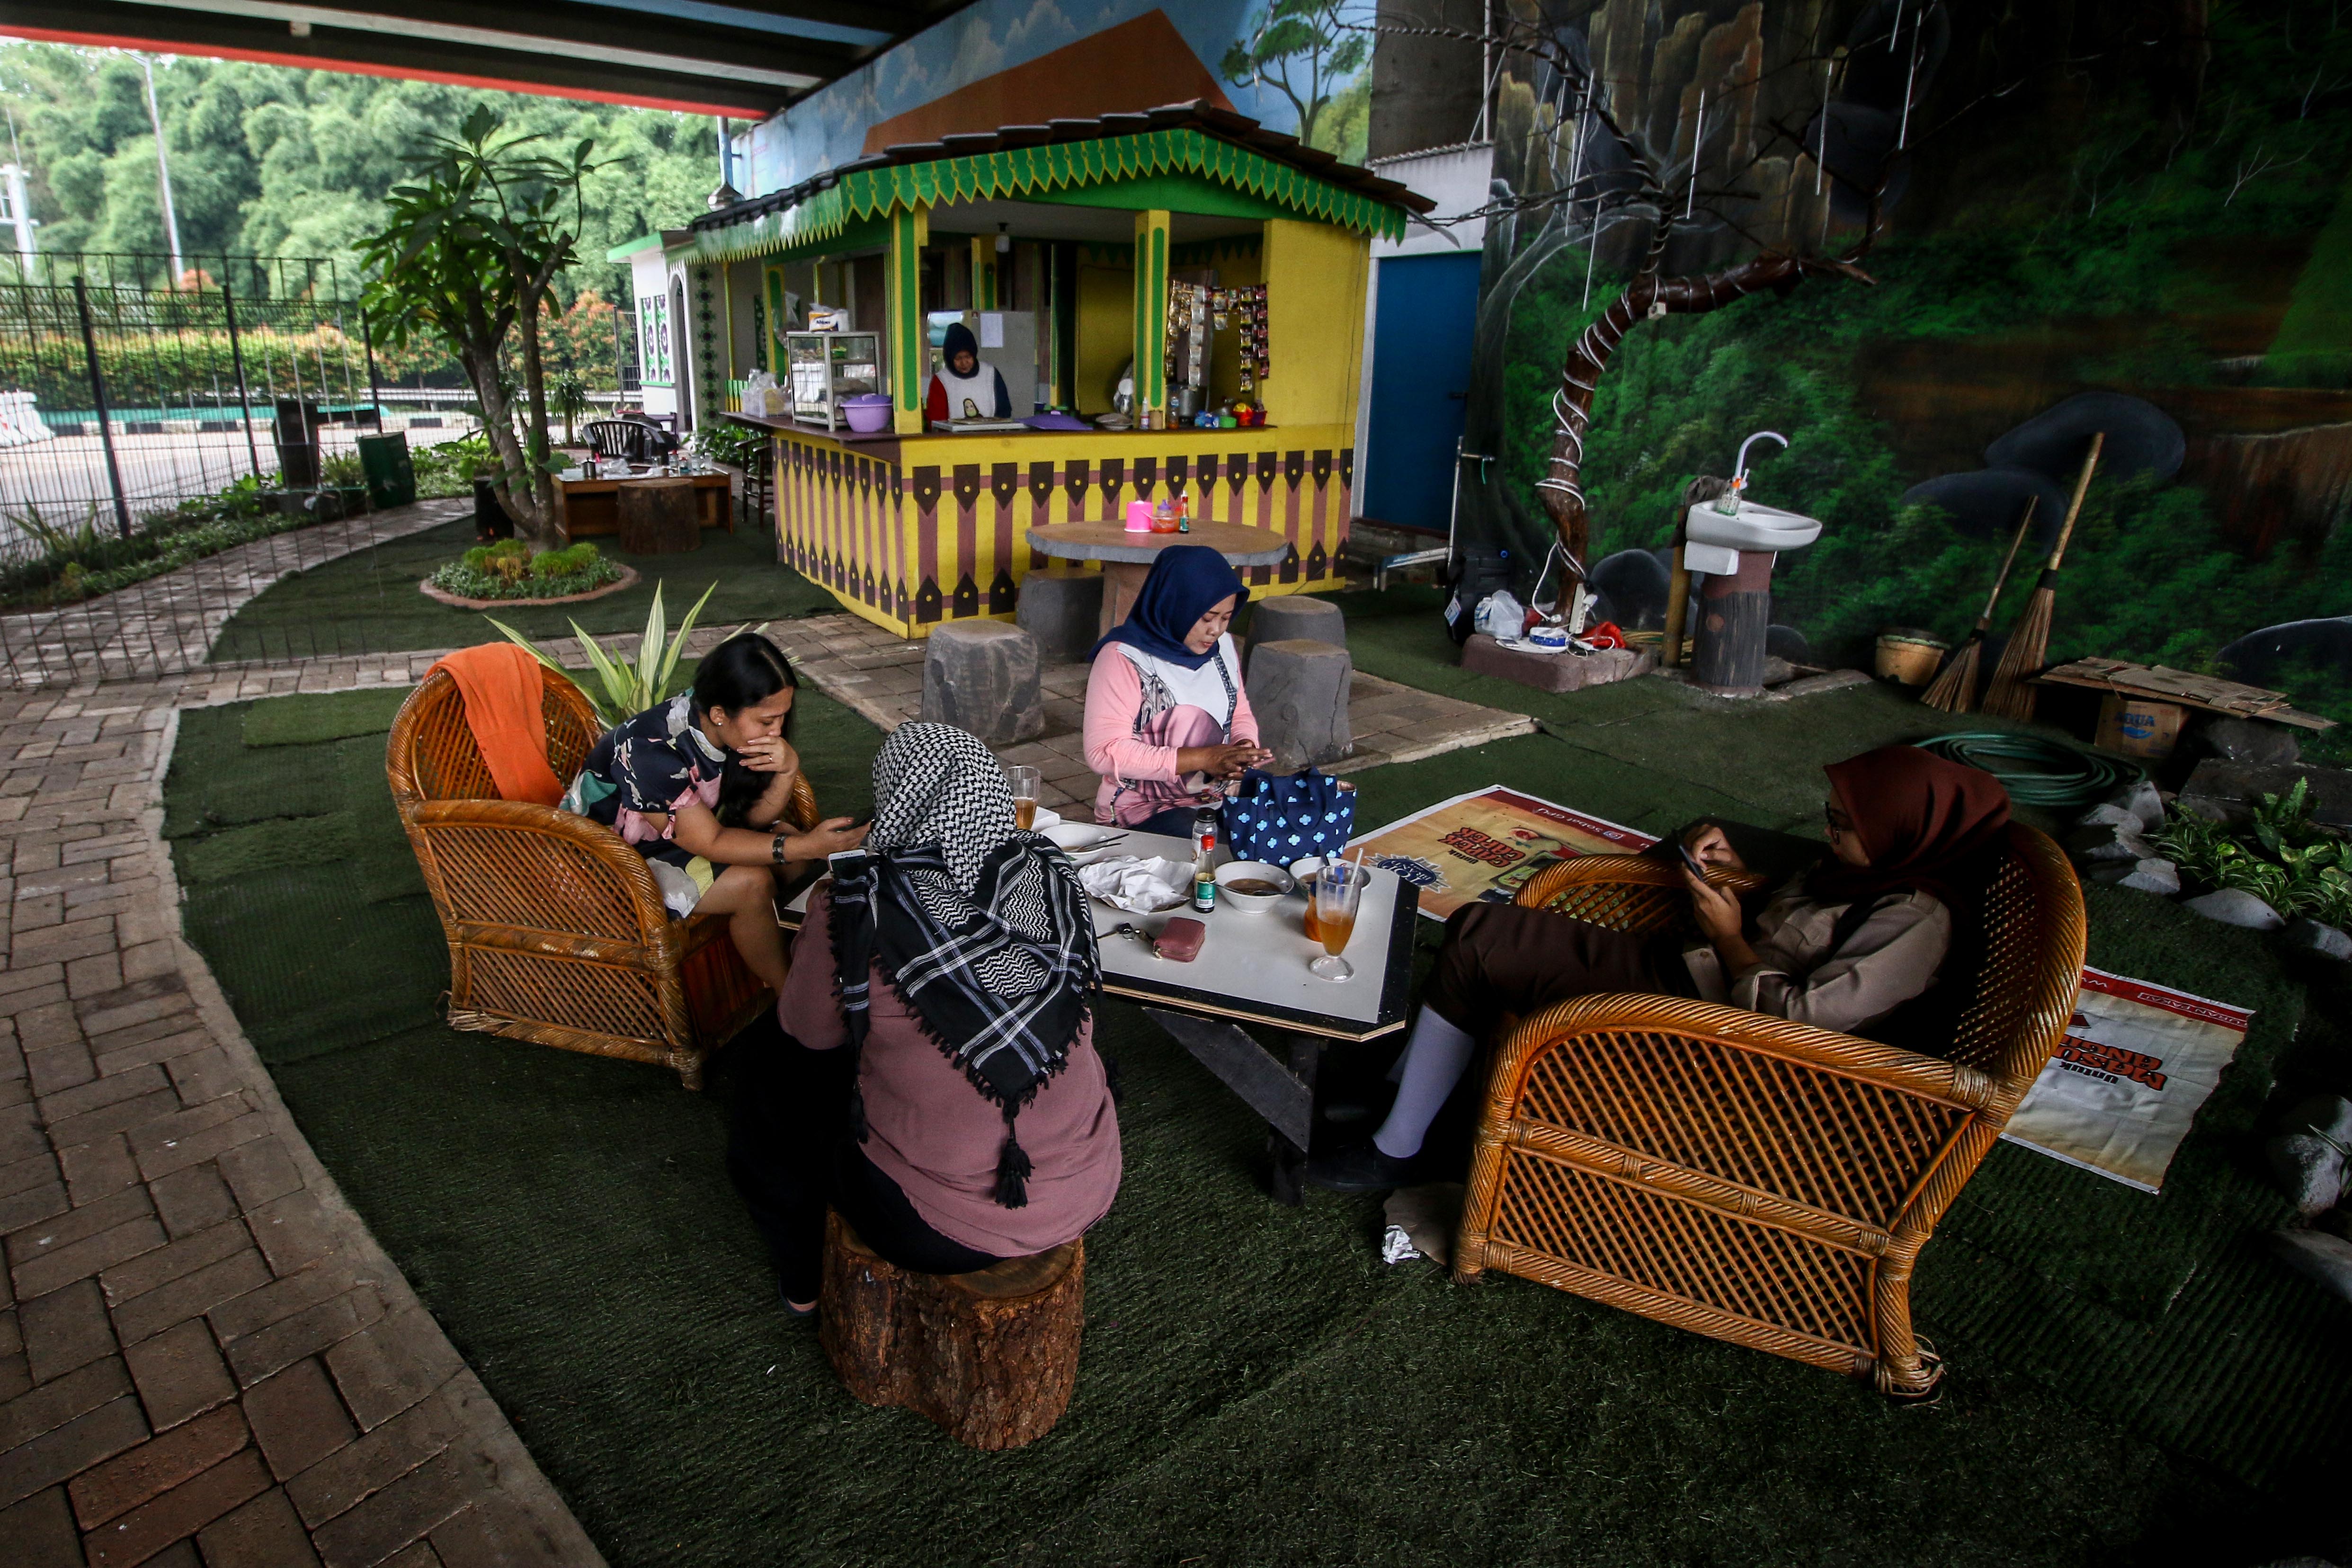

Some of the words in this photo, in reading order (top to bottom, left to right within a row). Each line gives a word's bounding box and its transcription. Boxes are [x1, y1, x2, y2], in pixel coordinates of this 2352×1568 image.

[2113, 711, 2155, 727] AQUA
[1437, 834, 1512, 868] CAPEK
[1452, 827, 1526, 861] CAPEK
[1381, 865, 1422, 885] TOP
[1391, 860, 1432, 881] BRAND
[2146, 995, 2191, 1010] PAKAI
[2052, 1044, 2168, 1091] MASU
[2058, 1061, 2119, 1084] Untuk
